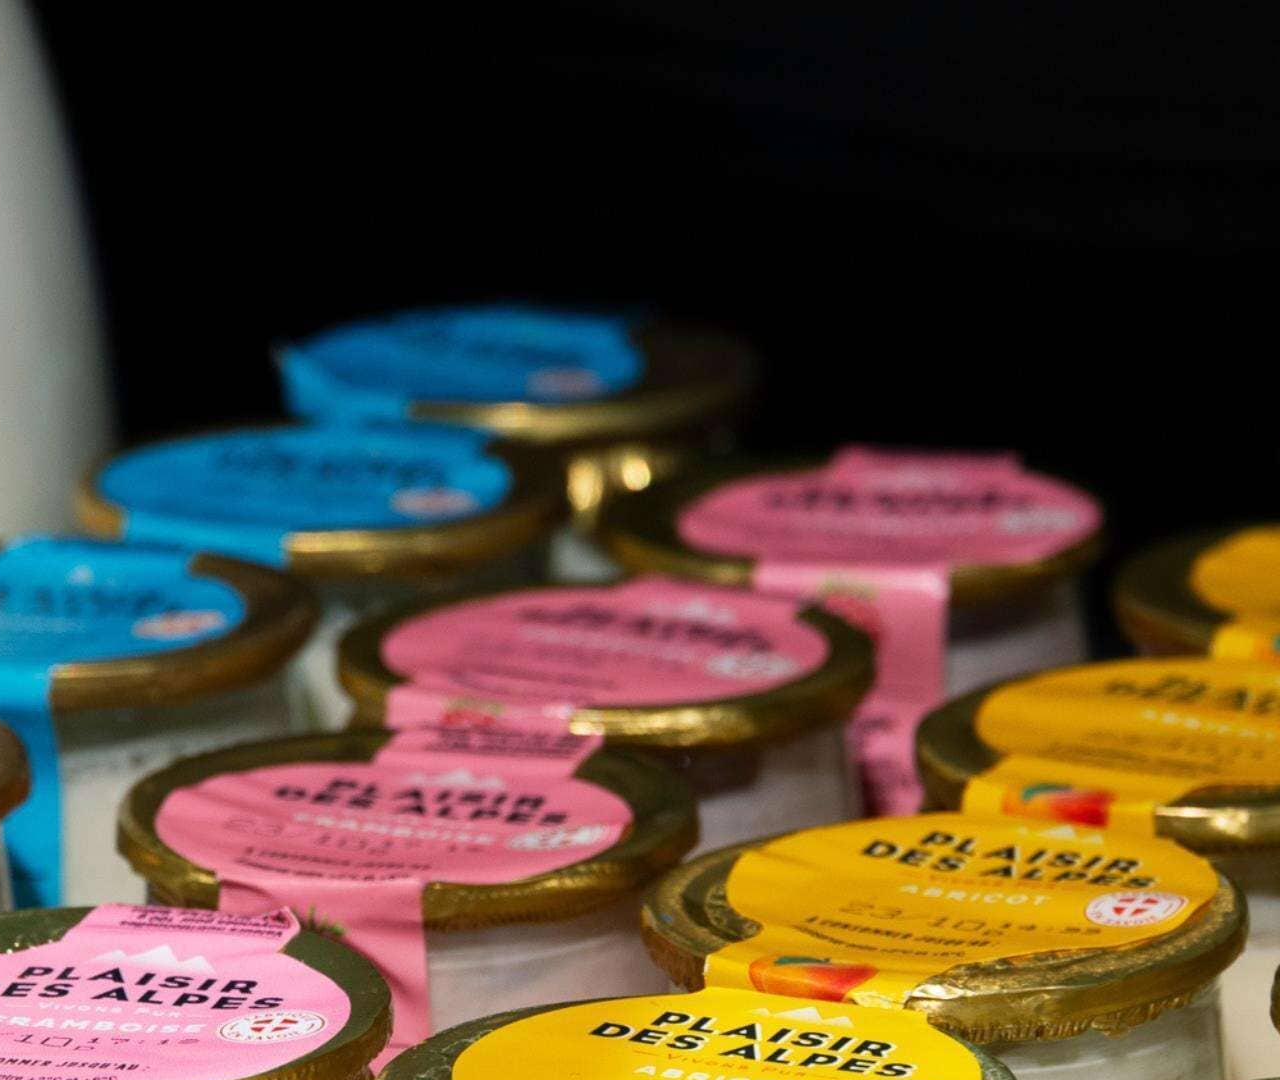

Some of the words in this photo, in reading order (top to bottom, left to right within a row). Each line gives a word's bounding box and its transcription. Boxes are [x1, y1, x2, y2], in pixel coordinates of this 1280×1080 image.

[860, 839, 969, 871] DES
[980, 862, 1158, 889] ALPES
[920, 831, 1141, 874] PLAISIR
[899, 883, 1052, 907] ABRICOT
[17, 966, 259, 995] PLAISIR
[92, 987, 285, 1010] ALPES
[589, 1021, 705, 1053] DES
[722, 1042, 918, 1080] ALPES
[650, 1010, 896, 1058] PLAISIR
